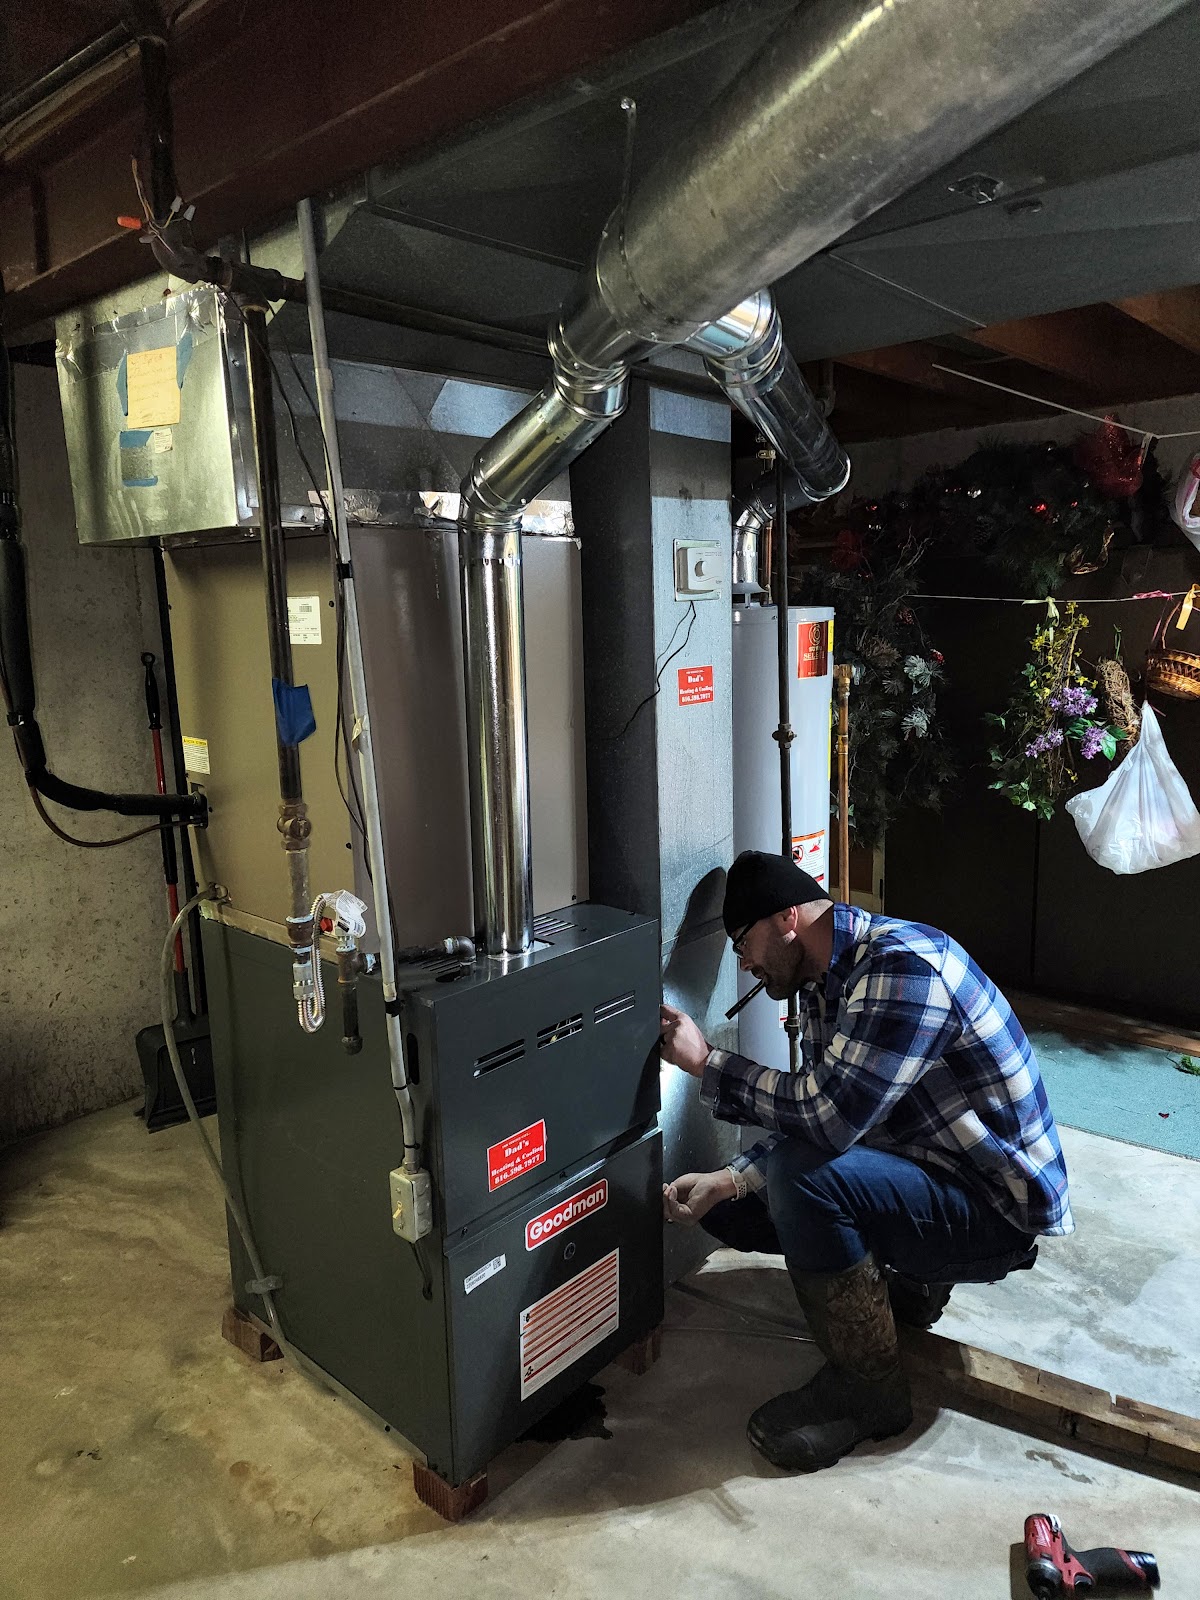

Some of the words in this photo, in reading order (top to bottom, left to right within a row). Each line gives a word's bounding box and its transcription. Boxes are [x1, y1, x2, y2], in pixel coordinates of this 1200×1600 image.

[803, 651, 825, 660] SELET
[687, 674, 704, 684] Dad's
[491, 1161, 515, 1177] Heating
[515, 1156, 521, 1164] &
[521, 1145, 544, 1160] Cooling
[504, 1140, 530, 1158] Dad's
[494, 1154, 540, 1185] 816.598.7977
[529, 1188, 604, 1240] Goodman
